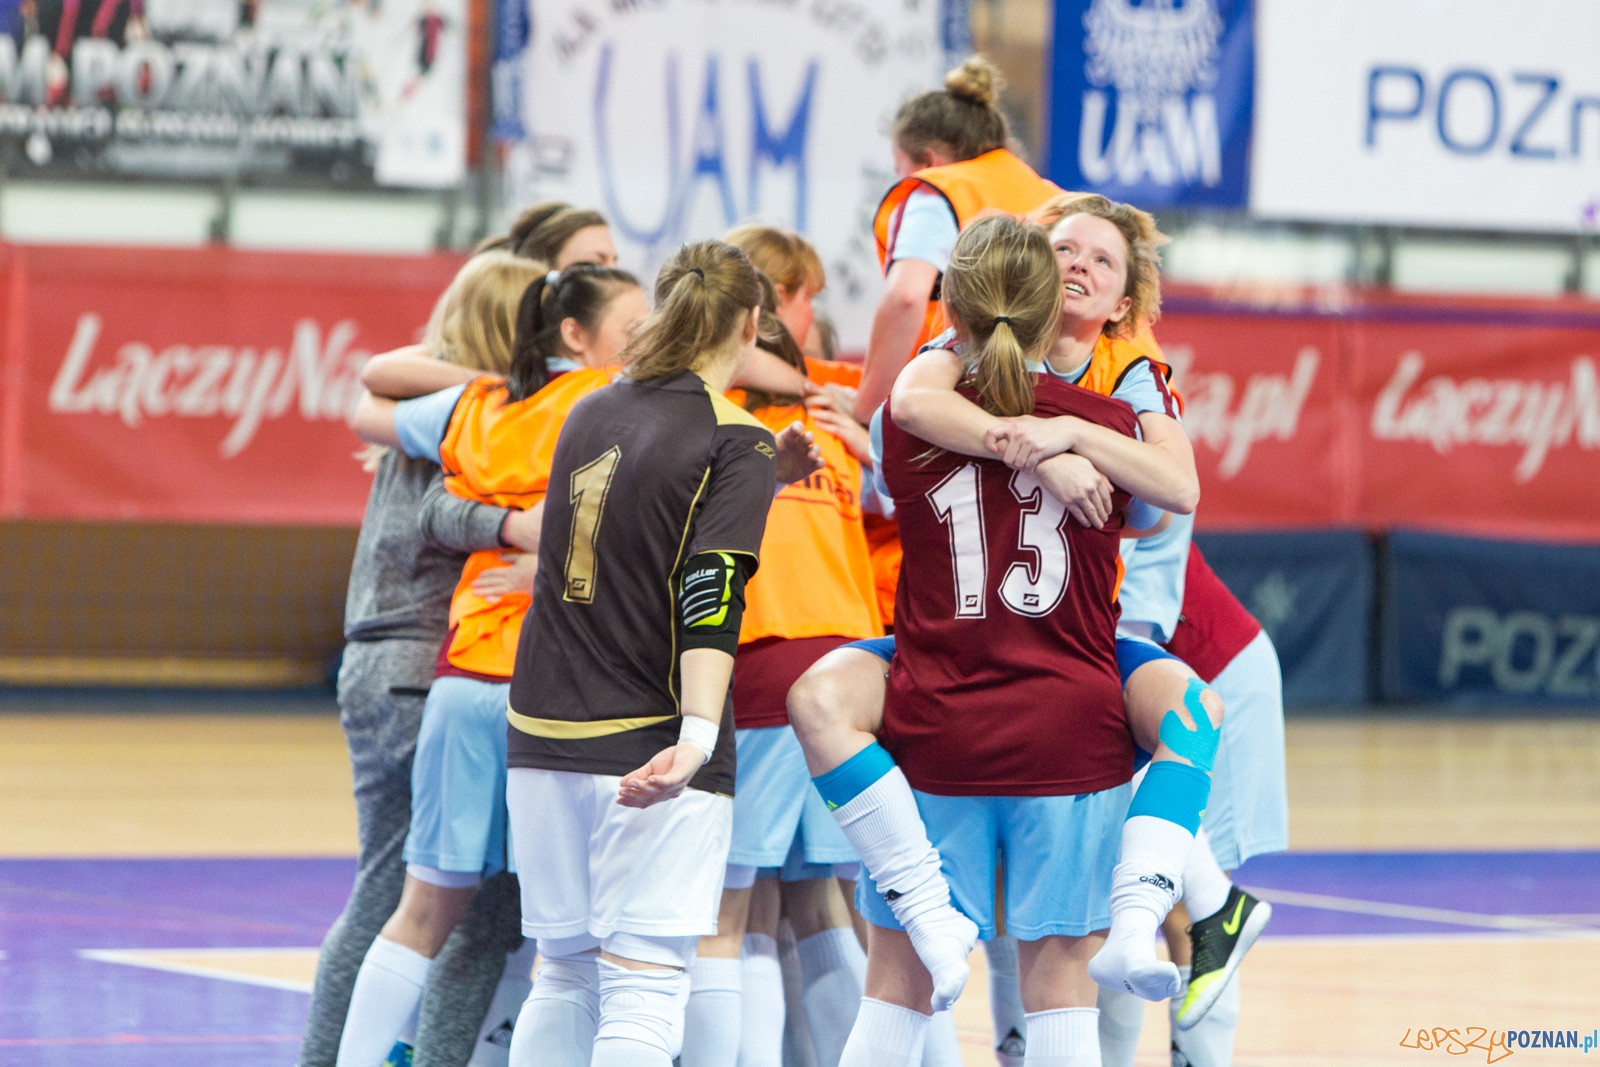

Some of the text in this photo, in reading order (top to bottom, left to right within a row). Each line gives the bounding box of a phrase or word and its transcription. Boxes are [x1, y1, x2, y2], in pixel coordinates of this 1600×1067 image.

[592, 42, 820, 244] UAM
[1078, 87, 1222, 187] UAM
[562, 445, 622, 605] 1
[685, 568, 720, 585] saller
[925, 461, 1071, 620] 13
[1437, 605, 1600, 695] POZ
